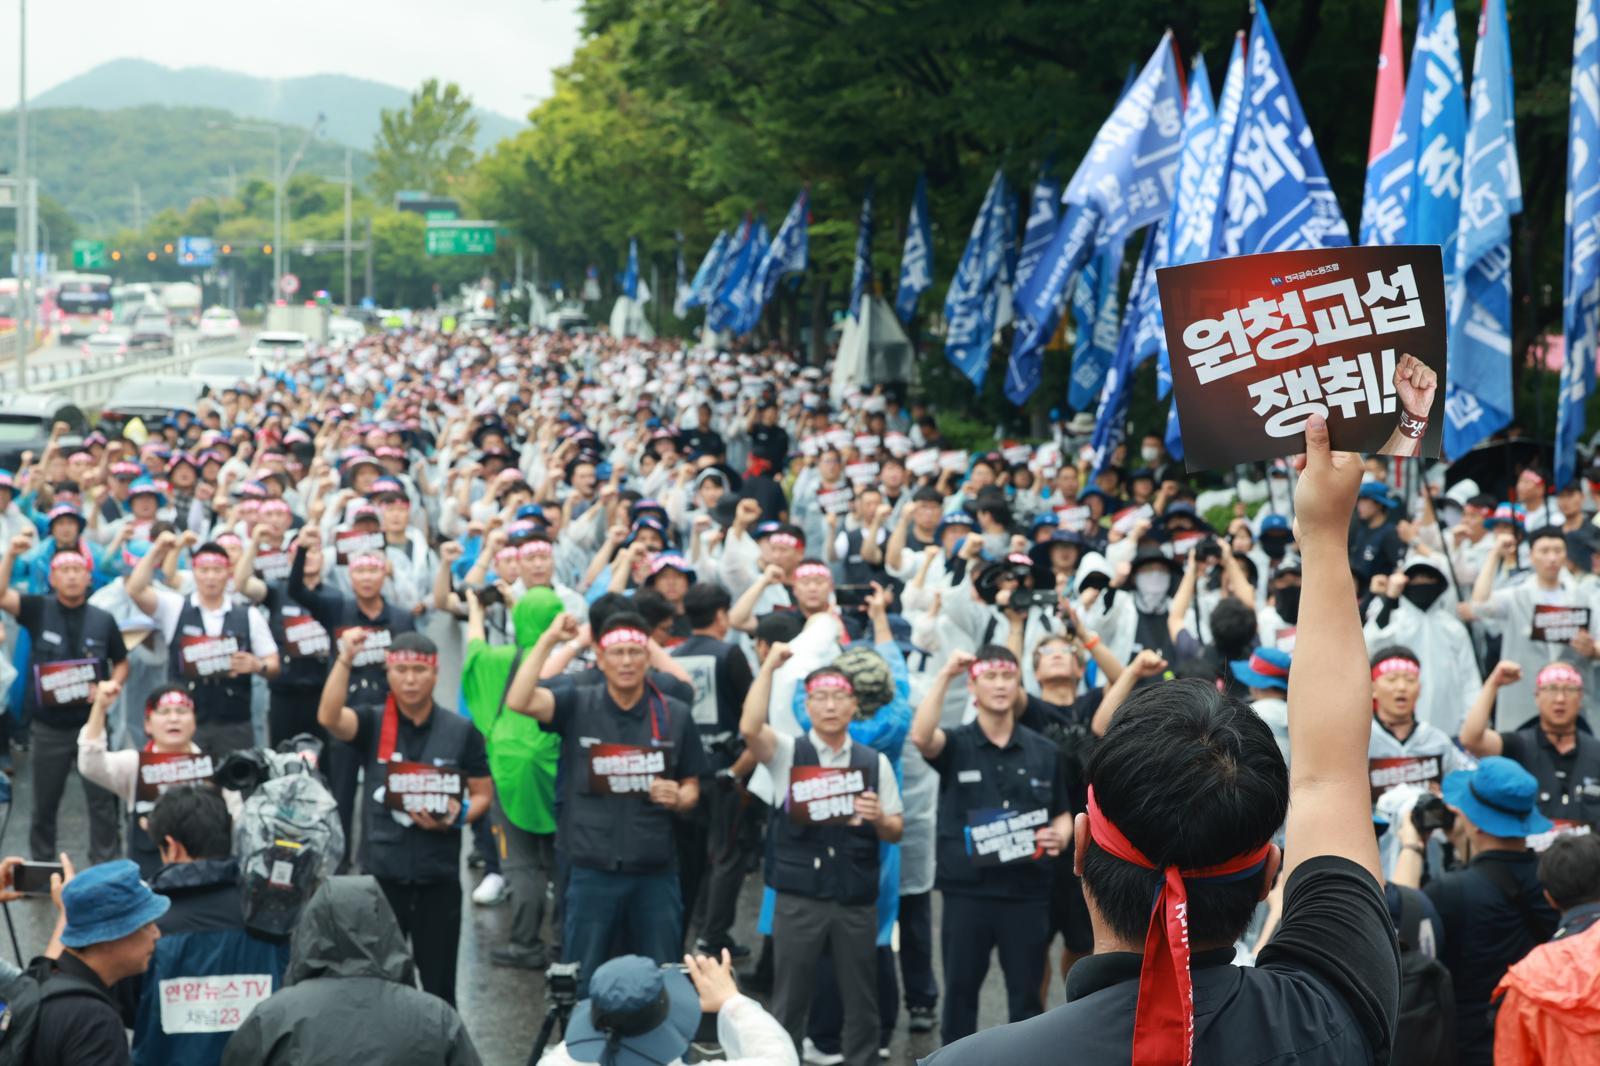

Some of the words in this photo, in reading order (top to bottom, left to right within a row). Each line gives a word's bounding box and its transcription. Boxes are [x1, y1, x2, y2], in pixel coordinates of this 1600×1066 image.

[1285, 263, 1340, 283] 전국금속노동조합
[1182, 264, 1426, 385] 원청교섭
[1247, 348, 1397, 438] 쟁취!
[165, 980, 268, 1003] 연합뉴스TV
[185, 1007, 241, 1025] 채널23
